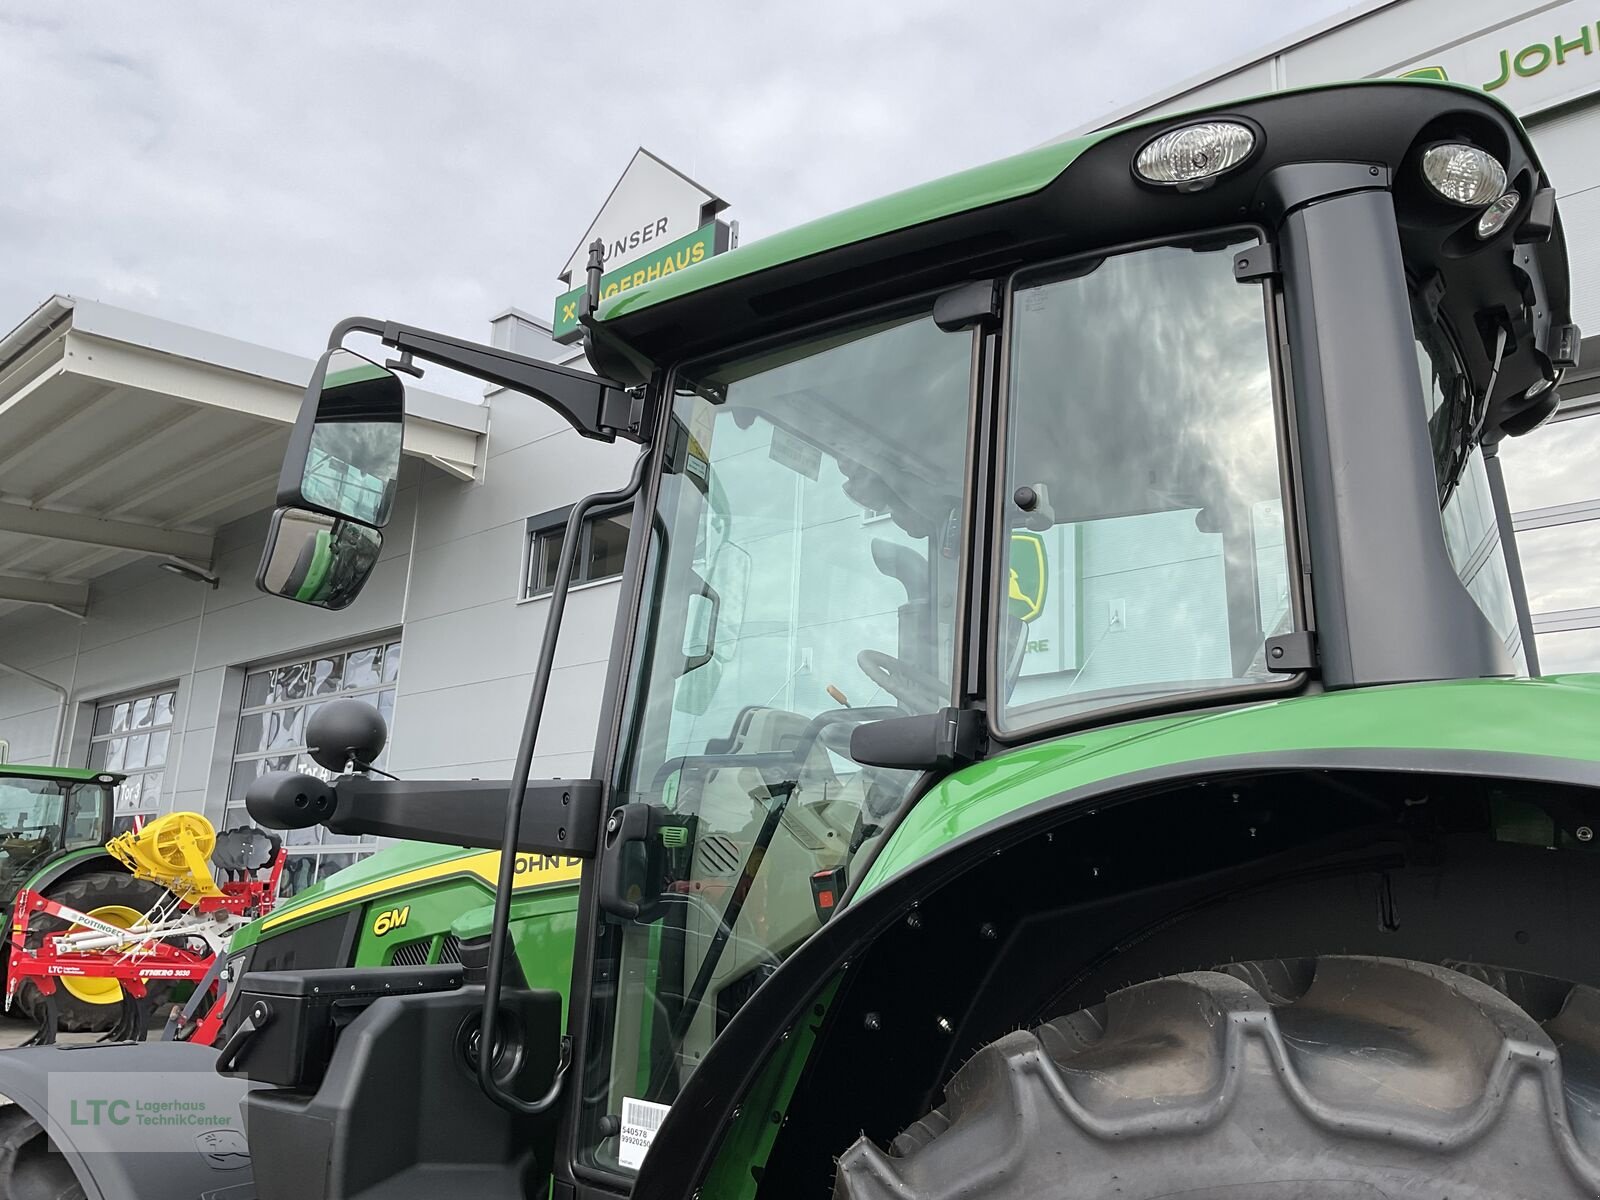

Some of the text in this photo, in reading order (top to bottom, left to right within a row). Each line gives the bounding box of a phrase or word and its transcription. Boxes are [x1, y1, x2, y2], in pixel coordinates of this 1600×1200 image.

[1483, 20, 1600, 91] JOH
[121, 782, 140, 800] Tor 3
[514, 854, 560, 874] OHN
[373, 905, 410, 937] 6M
[48, 965, 63, 974] LTC
